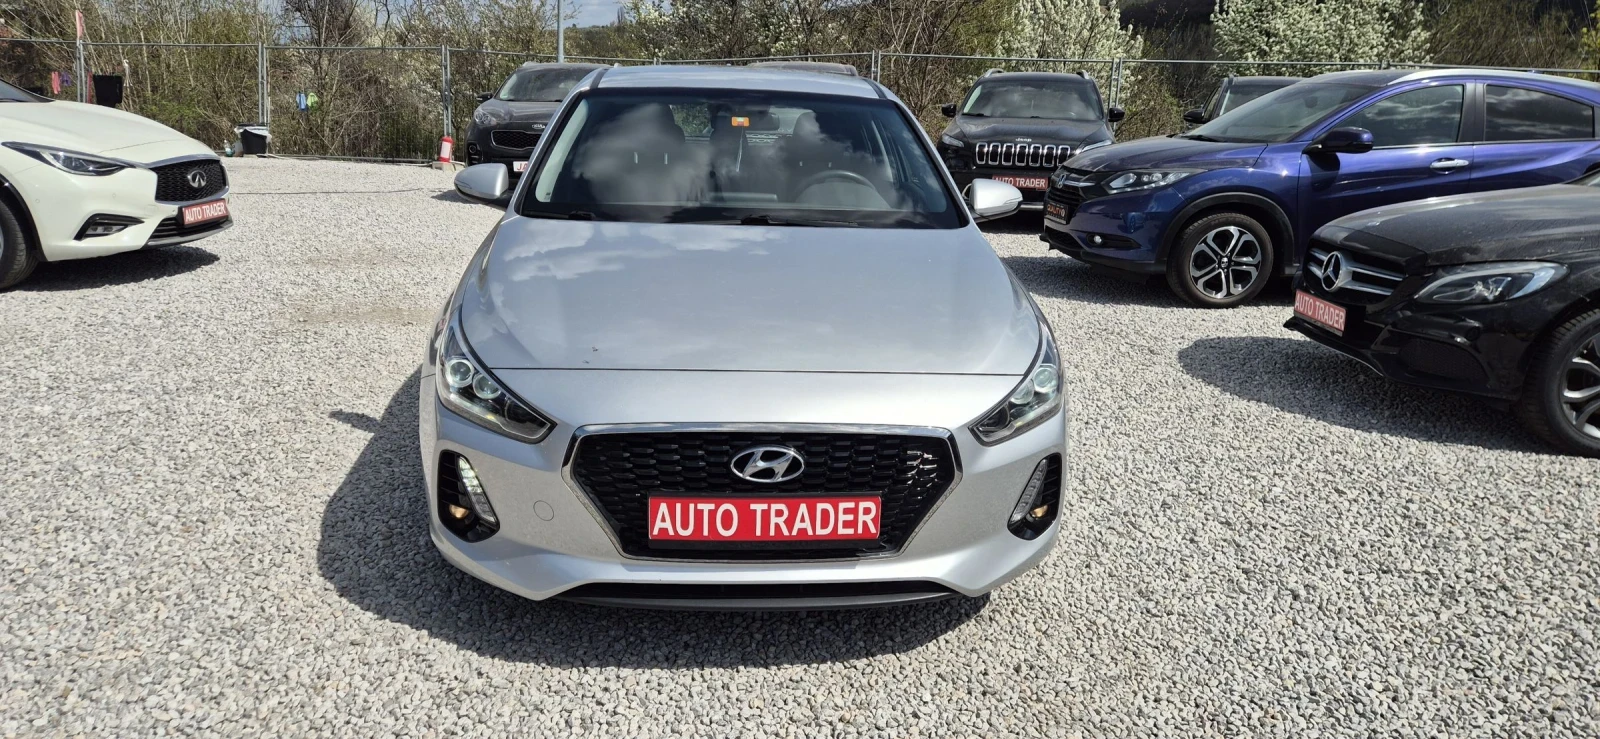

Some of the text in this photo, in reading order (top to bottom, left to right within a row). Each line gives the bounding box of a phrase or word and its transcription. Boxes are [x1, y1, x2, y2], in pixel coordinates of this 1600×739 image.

[1016, 178, 1045, 187] TRADER
[185, 202, 226, 222] AUTO TRADER
[1295, 293, 1314, 316] AUTO
[1315, 301, 1345, 331] TRADER
[652, 501, 877, 537] AUTO TRADER
